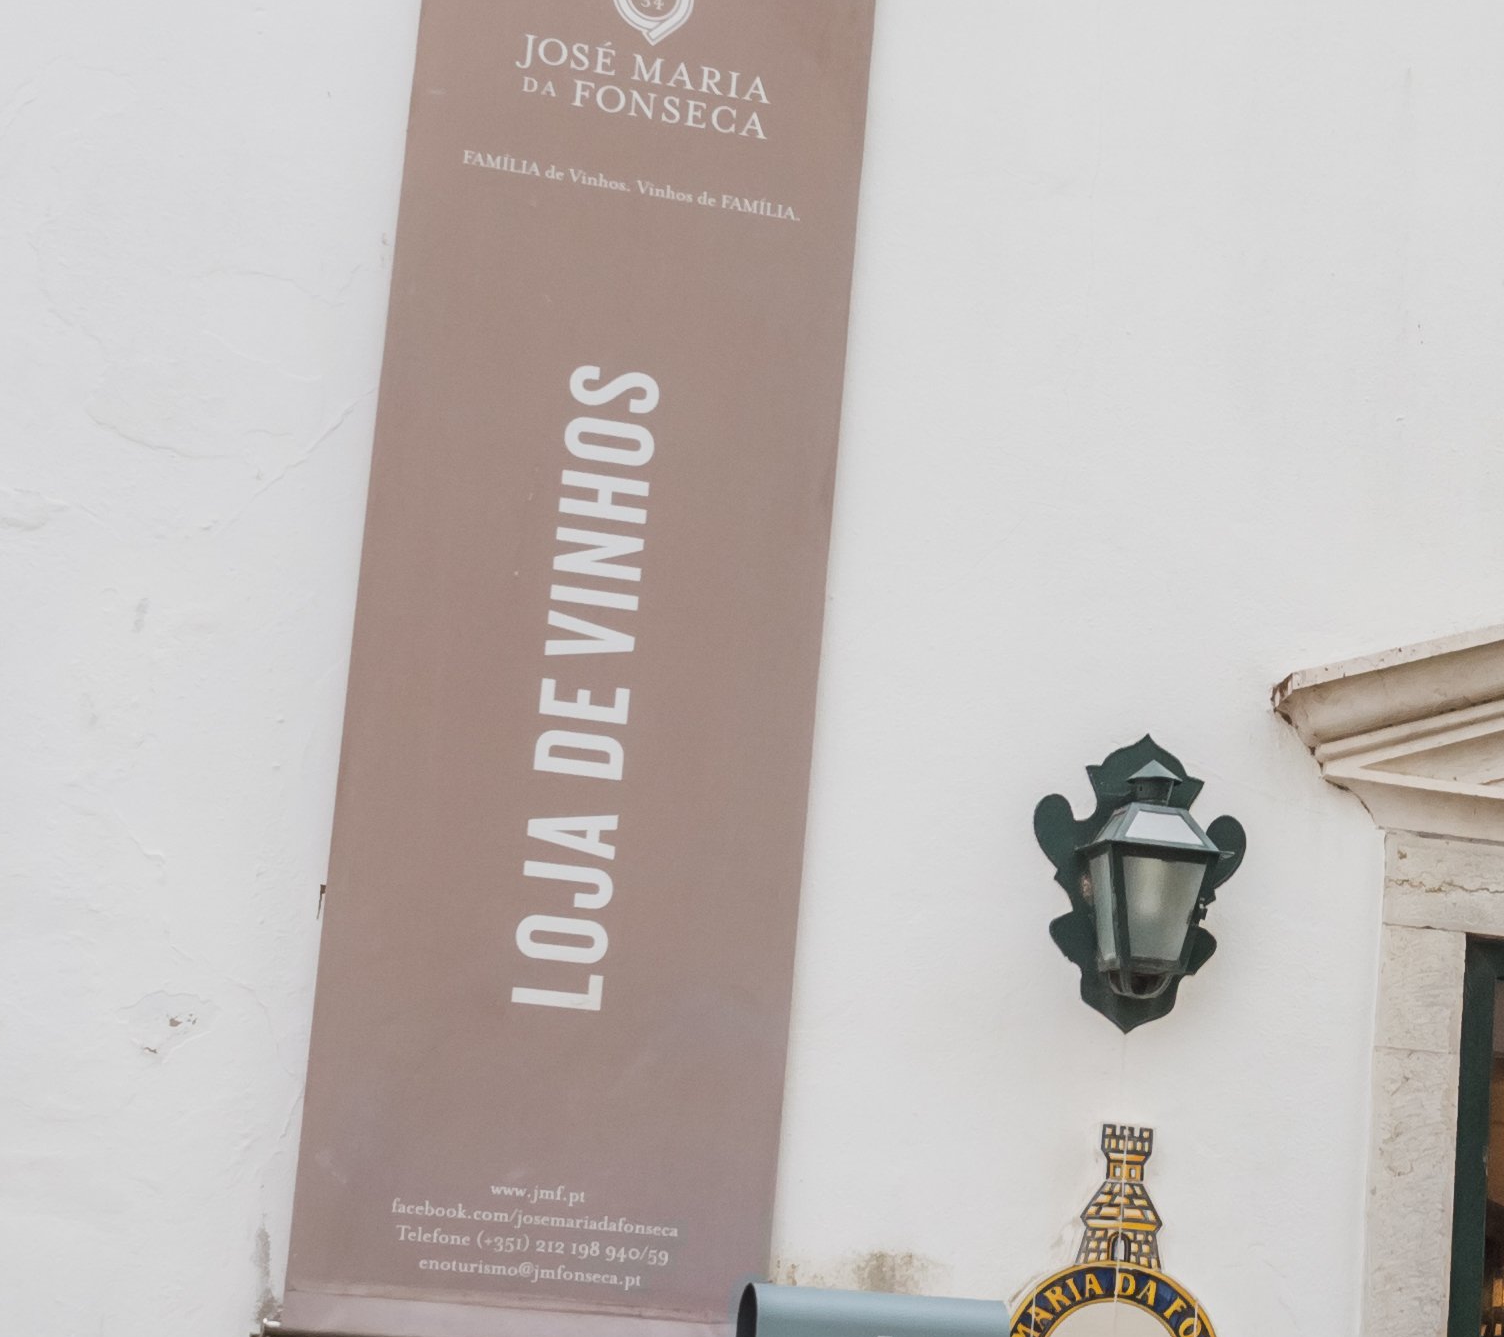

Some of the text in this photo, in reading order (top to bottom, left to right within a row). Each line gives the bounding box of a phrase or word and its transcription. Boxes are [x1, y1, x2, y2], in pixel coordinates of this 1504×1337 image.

[515, 32, 772, 105] JOSÉ MARIA
[522, 76, 768, 141] DA FONSECA
[462, 148, 801, 222] FAMÍLIA de Vinhos. Vinhos de FAMÍLIA.
[510, 364, 661, 1012] LOJA DE VINHOS
[490, 1184, 586, 1206] www.jmf.pt
[391, 1197, 679, 1238] facebook.com/josemariadafonseca
[396, 1225, 669, 1267] Telefone (+351) 212 198 940/59
[418, 1257, 641, 1290] enoturismo@jmfonseca.pt
[1117, 1273, 1158, 1307] DA
